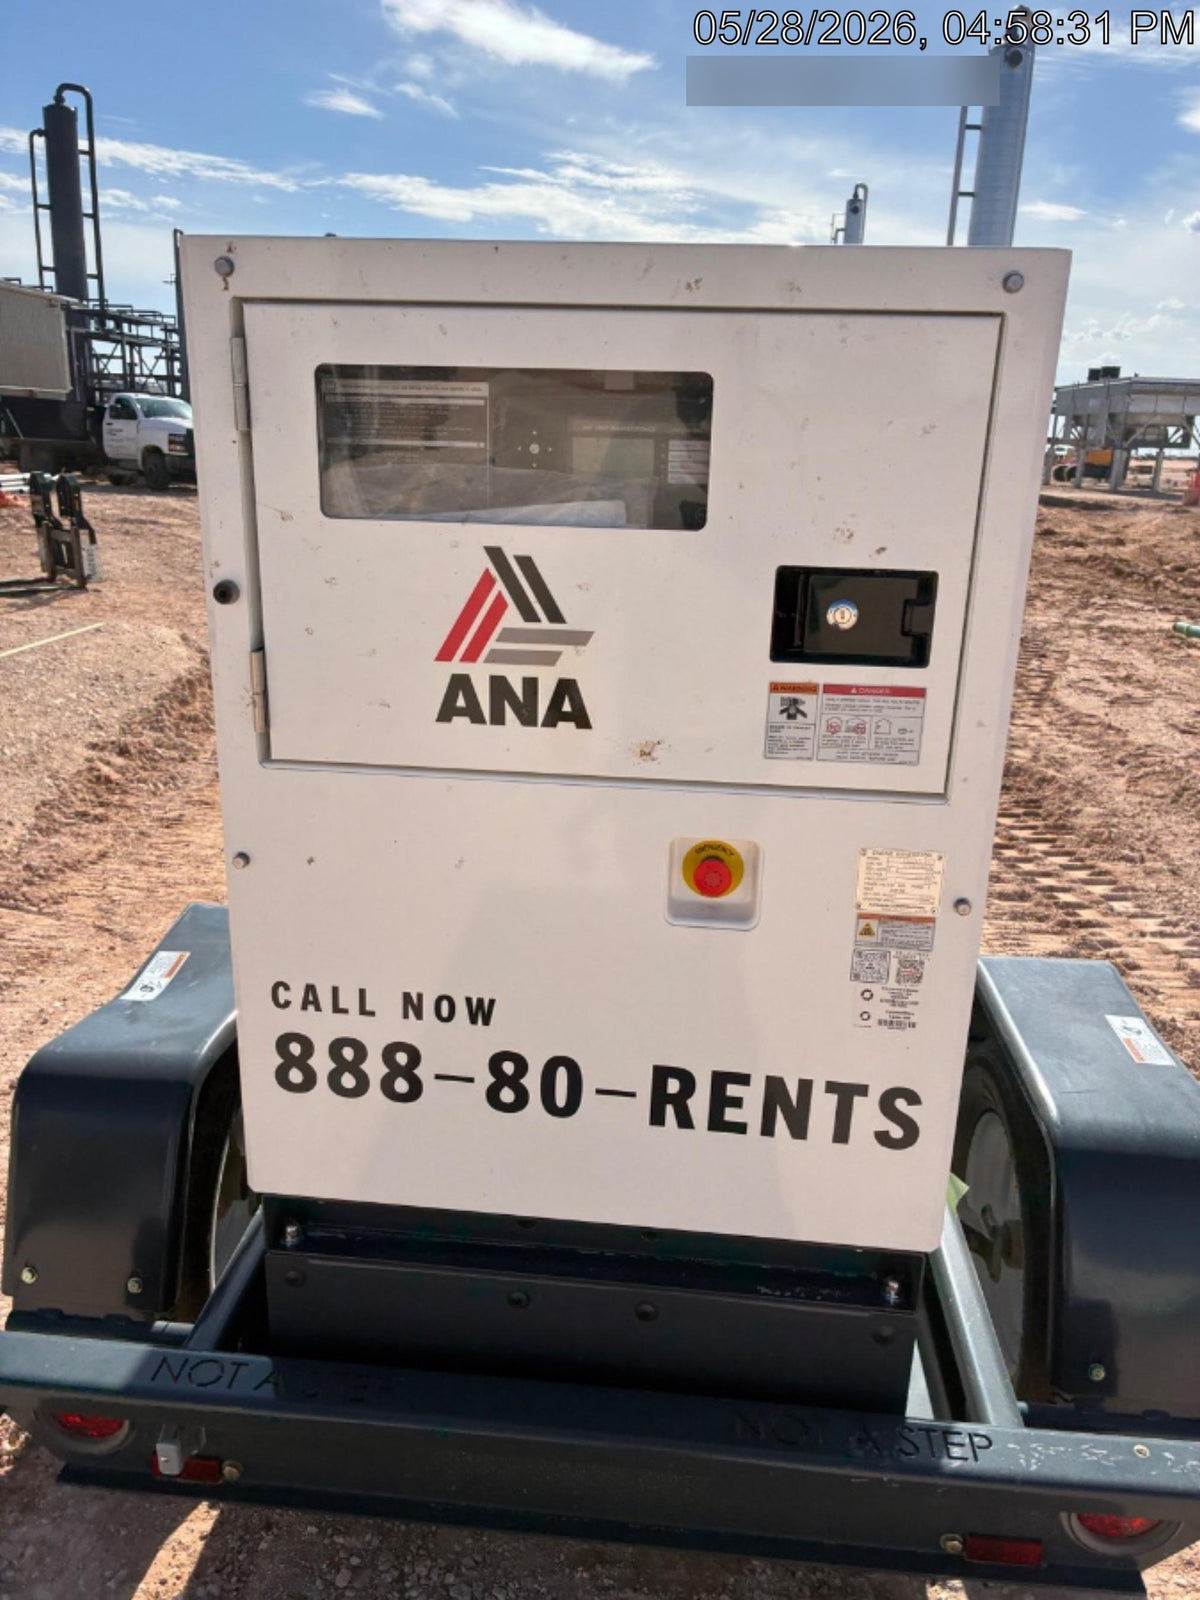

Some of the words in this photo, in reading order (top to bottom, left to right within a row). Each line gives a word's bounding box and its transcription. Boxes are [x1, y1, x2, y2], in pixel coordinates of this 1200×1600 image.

[435, 673, 592, 729] ANA
[271, 980, 376, 1017] CALL
[402, 991, 496, 1027] NOW
[274, 1031, 923, 1151] 888-80-RENTS
[151, 1356, 249, 1389] NOT
[253, 1367, 284, 1392] A
[897, 1425, 993, 1462] STEP
